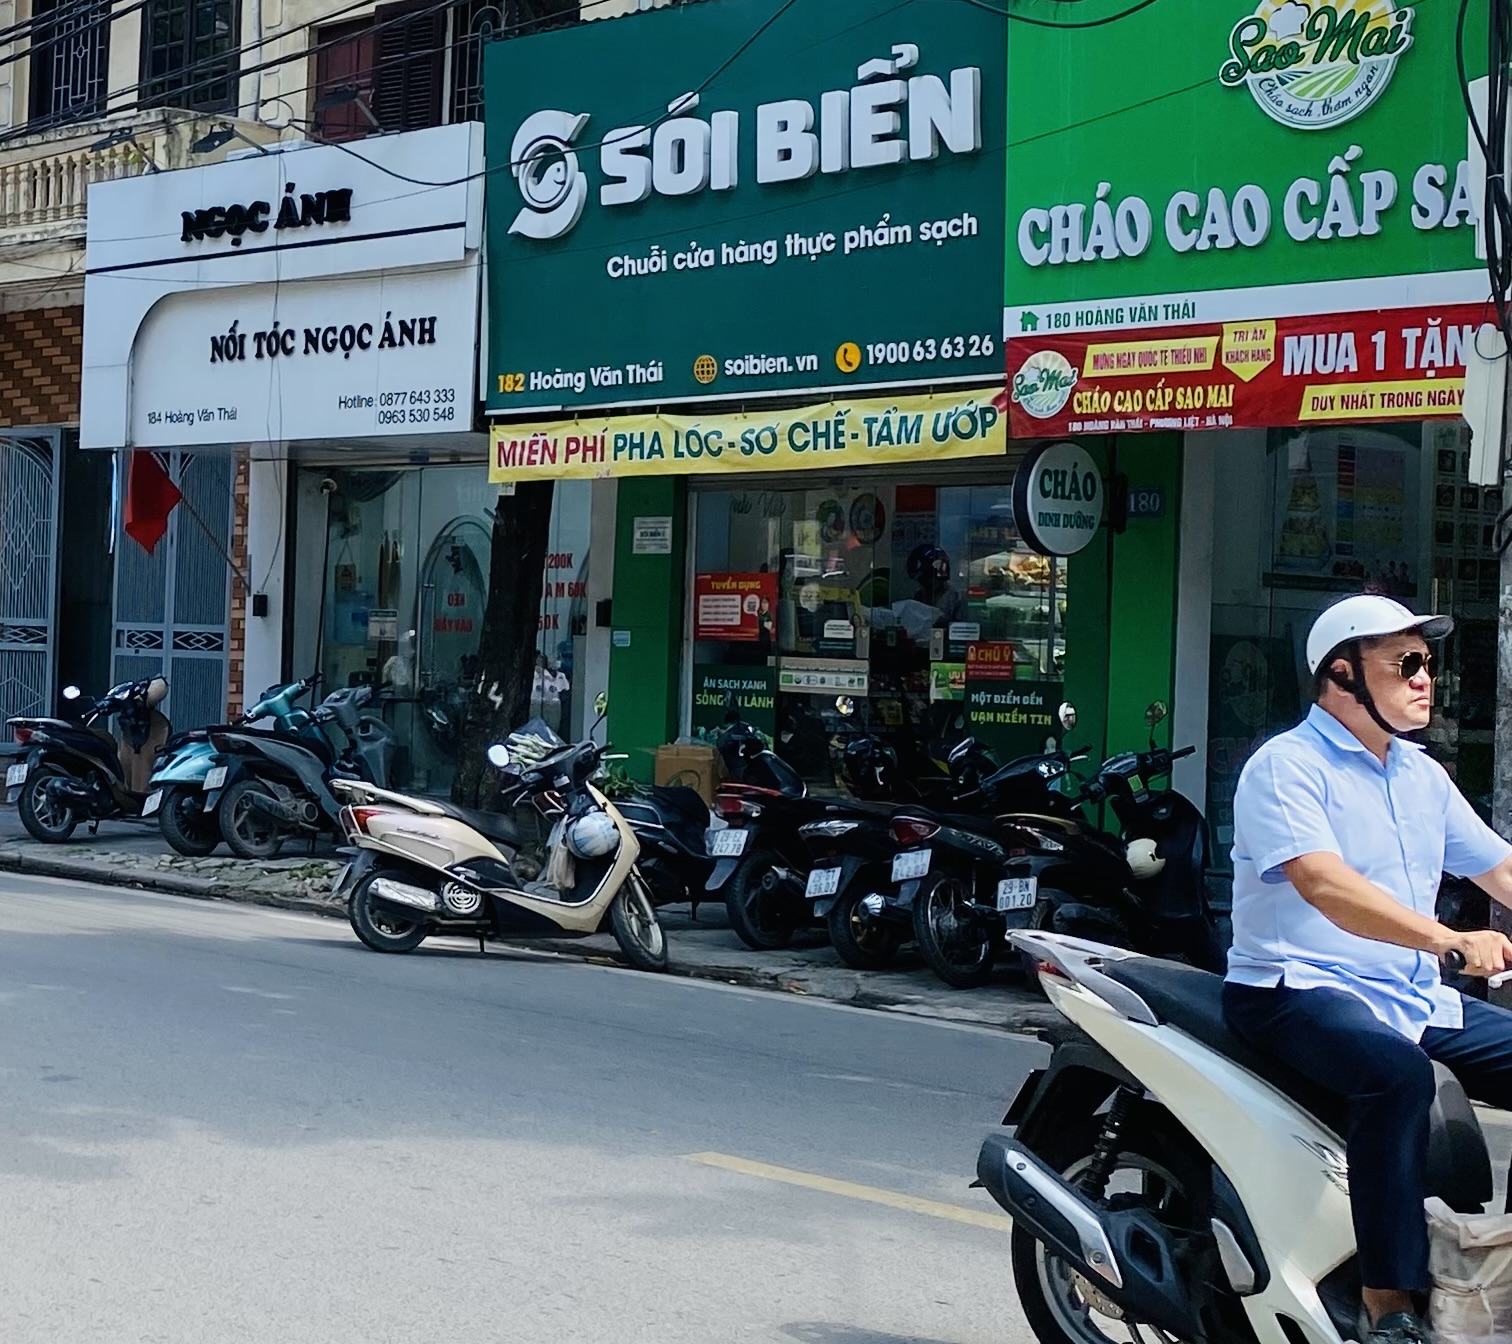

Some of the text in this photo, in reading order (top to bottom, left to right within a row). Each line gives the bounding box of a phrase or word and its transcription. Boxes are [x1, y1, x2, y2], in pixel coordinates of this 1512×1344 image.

[1221, 5, 1408, 83] Sao Mai
[600, 43, 982, 207] SÓI BIỂN
[1018, 144, 1479, 267] CHÁO CAO CẤP SA
[181, 200, 271, 246] NGỌC
[607, 212, 979, 278] Chuỗi cửa hàng thực phẩm sạch
[1047, 297, 1196, 330] 180 HOÀNG VĂN THÁI
[210, 311, 437, 363] NỐI TÓC NGỌC ÁNH
[1233, 330, 1248, 342] TRI
[1283, 317, 1472, 378] MUA 1 TẶN
[498, 374, 525, 393] 182
[530, 367, 585, 393] Hoàng
[590, 365, 622, 387] Văn
[626, 359, 663, 384] Thái
[867, 341, 909, 365] 1900
[913, 339, 936, 362] 63
[941, 336, 965, 359] 63
[969, 334, 994, 357] 26
[379, 392, 407, 407] 0877
[409, 390, 431, 405] 643
[433, 388, 455, 404] 333
[1073, 377, 1235, 414] CHÁO CAO CẤP SAO MAI
[1312, 386, 1464, 412] DUY NHẤT TRONG NGÀY
[165, 410, 194, 426] Hoàng
[197, 409, 215, 423] Văn
[217, 407, 237, 421] Thái
[378, 406, 455, 424] 0963 530 548
[497, 432, 558, 468] MIỄN
[565, 427, 608, 464] PHÍ
[614, 430, 665, 461] PHA
[932, 400, 998, 443] ƯỚP
[1040, 461, 1096, 502] CHÁO
[1129, 492, 1160, 513] 180
[1038, 512, 1060, 528] DINH
[742, 680, 767, 690] XANH
[744, 693, 775, 709] LÀNH
[971, 691, 992, 706] MỘT
[971, 711, 994, 725] VẠN
[1030, 714, 1052, 726] TIN
